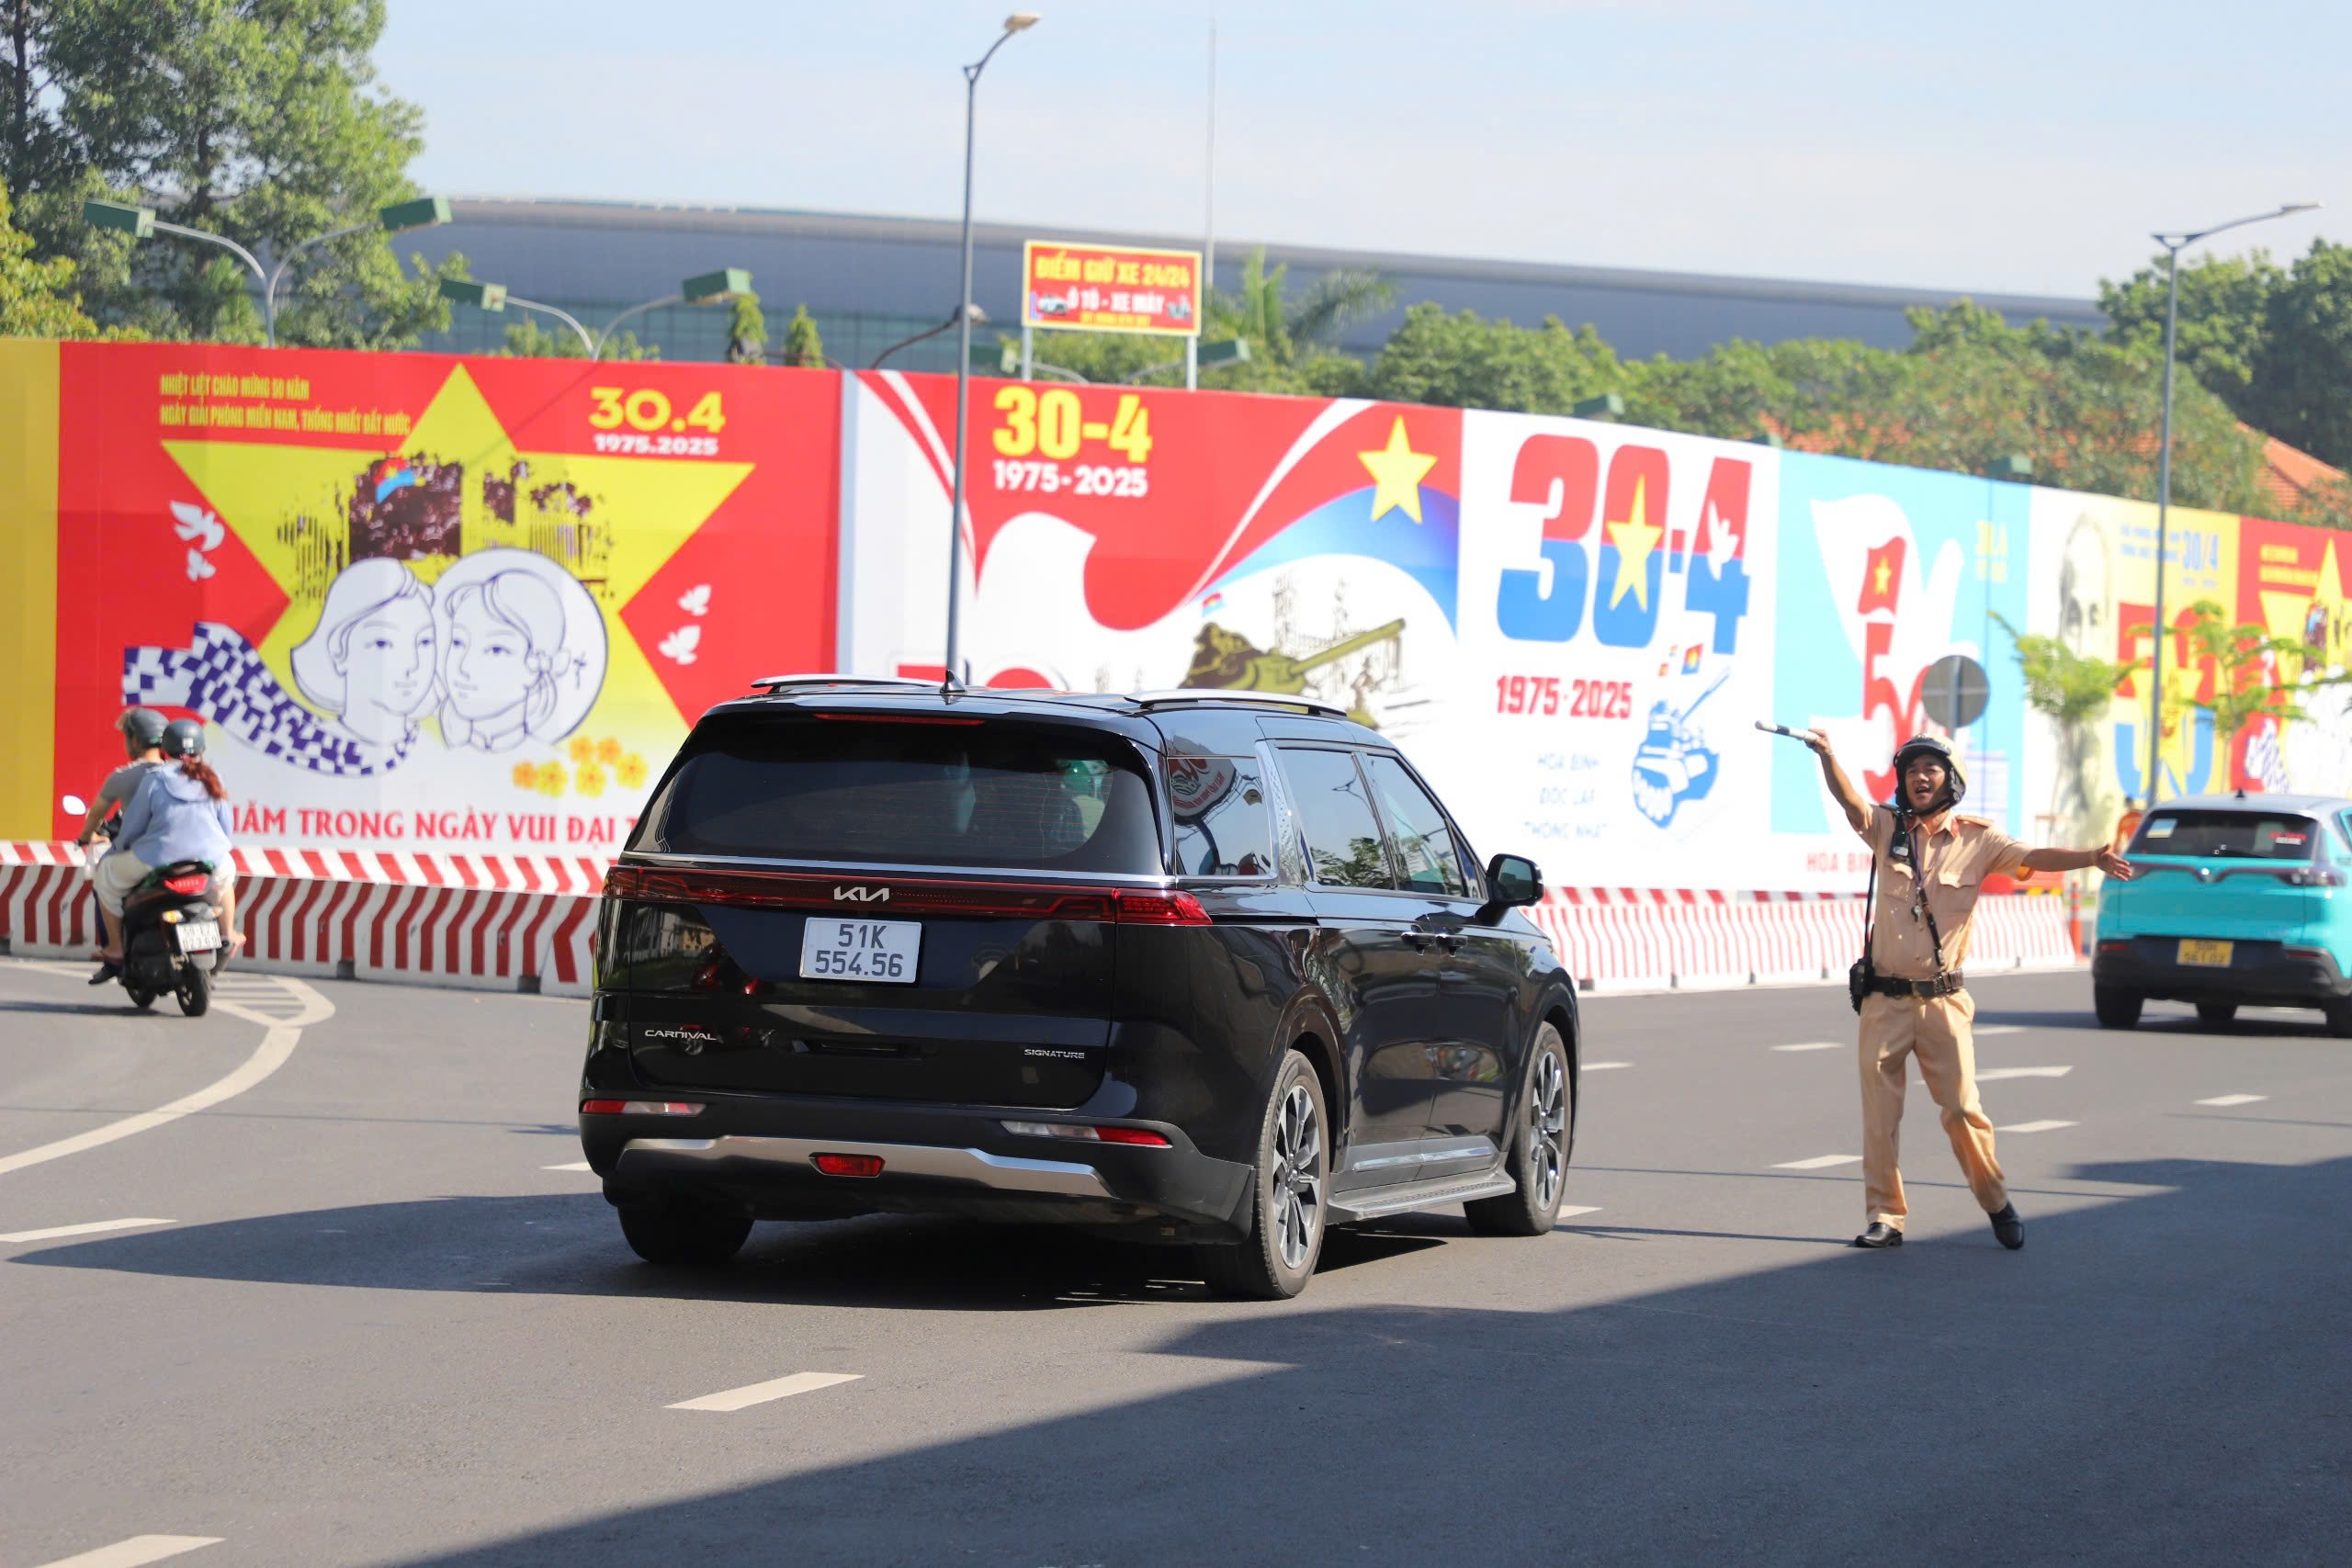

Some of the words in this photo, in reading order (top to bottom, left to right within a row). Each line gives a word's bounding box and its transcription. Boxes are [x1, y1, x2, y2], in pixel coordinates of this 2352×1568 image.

[1116, 263, 1139, 285] XE
[1110, 291, 1131, 312] XE
[588, 386, 727, 433] 30.4
[992, 385, 1153, 463] 30-4
[594, 433, 719, 456] 1975.2025
[992, 459, 1149, 498] 1975-2025
[297, 807, 404, 840] TRONG
[415, 805, 498, 840] NGÀY
[507, 812, 557, 842] VUI
[567, 815, 616, 850] ĐẠI
[838, 923, 888, 950] 51K
[815, 950, 904, 977] 554.56
[644, 1029, 718, 1041] CARNIVAL
[1023, 1048, 1085, 1059] SIGNATURE
